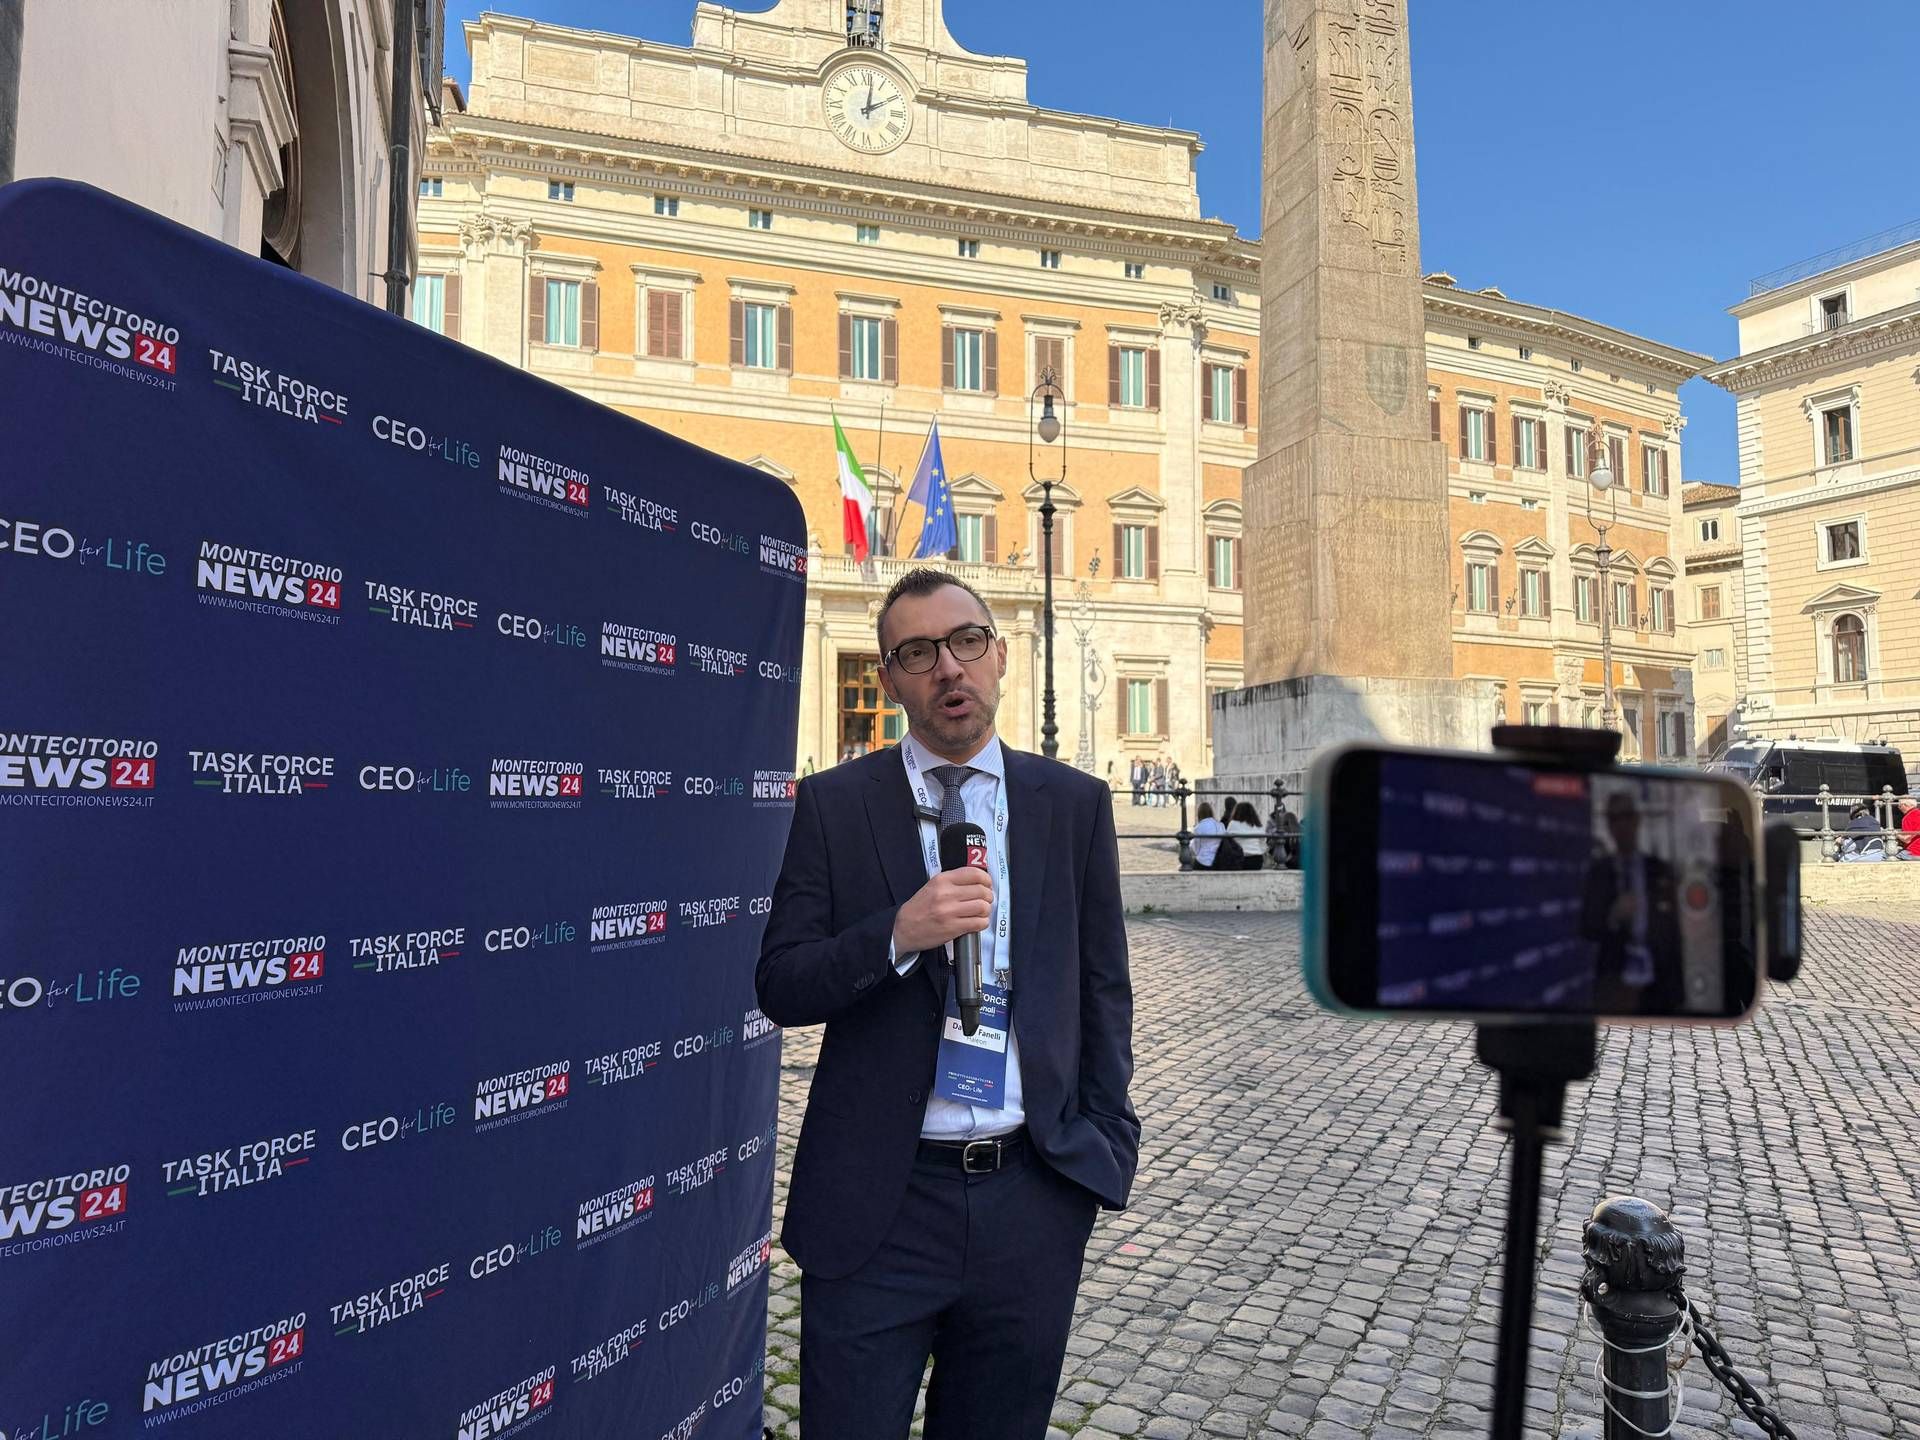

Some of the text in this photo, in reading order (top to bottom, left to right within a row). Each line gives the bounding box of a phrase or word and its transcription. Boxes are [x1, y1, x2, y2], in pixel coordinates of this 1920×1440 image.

[0, 267, 180, 345] MONTECITORIO
[0, 289, 172, 370] NEWS 24
[209, 349, 348, 416] TASK FORCE
[241, 380, 319, 424] ITALIA
[372, 415, 480, 469] CEO for Life
[498, 459, 587, 504] NEWS 24
[499, 444, 589, 486] MONTECITORIO
[603, 485, 678, 524] TASK FORCE
[620, 506, 662, 532] ITALIA
[691, 520, 721, 545] CEO
[728, 533, 750, 555] Life
[78, 537, 103, 566] for
[106, 538, 166, 576] Life
[199, 541, 342, 583] MONTECITORIO
[759, 545, 797, 571] NEWS
[197, 560, 337, 606] NEWS 24
[365, 581, 478, 618] TASK FORCE
[198, 593, 341, 625] WWW.MONTECITORIONEWS24.IT
[391, 605, 453, 631] ITALIA
[497, 613, 587, 648] CEO Life
[602, 621, 676, 646] MONTECITORIO
[601, 636, 674, 663] NEWS 24
[687, 643, 748, 666] TASK FORCE
[701, 659, 735, 676] ITALIA
[759, 660, 781, 680] CEO
[115, 762, 151, 786] 24
[188, 751, 334, 776] TASK FORCE
[359, 765, 415, 791] CEO
[433, 767, 471, 792] Life
[491, 758, 583, 775] MONTECITORIO
[598, 768, 672, 785] TASK FORCE
[222, 773, 302, 795] ITALIA
[489, 774, 580, 797] NEWS 24
[614, 784, 656, 799] ITALIA
[684, 777, 714, 796] CEO
[723, 777, 744, 797] Life
[752, 782, 787, 798] NEWS
[490, 800, 582, 809] WWW.MONTECITORIONEWS24.IT
[592, 900, 667, 920] MONTECITORIO
[679, 896, 740, 916] TASK FORCE
[692, 911, 726, 928] ITALIA
[749, 896, 772, 915] CEO
[349, 928, 465, 957] TASK FORCE
[484, 926, 530, 952] CEO
[544, 921, 576, 945] Life
[590, 914, 664, 942] NEWS 24
[176, 935, 326, 966] MONTECITORIO
[375, 948, 439, 973] ITALIA
[46, 979, 75, 1008] for
[76, 968, 141, 1002] Life
[173, 955, 320, 996] NEWS 24
[173, 984, 323, 1013] WWW.MONTECITORIONEWS24.IT
[981, 993, 1008, 1007] ORCE
[673, 1034, 704, 1060] CEO
[714, 1025, 734, 1048] Life
[978, 1028, 1001, 1041] Fanelli
[585, 1041, 661, 1075] TASK FORCE
[602, 1061, 645, 1085] ITALIA
[476, 1060, 570, 1096] MONTECITORIO
[474, 1076, 567, 1120] NEWS 24
[341, 1116, 399, 1151] CEO
[417, 1103, 456, 1132] Life
[162, 1129, 316, 1183] TASK FORCE
[738, 1135, 760, 1162] CEO
[198, 1158, 283, 1196] ITALIA
[666, 1147, 729, 1186] TASK FORCE
[680, 1168, 714, 1195] ITALIA
[85, 1188, 121, 1218] 24
[578, 1174, 655, 1216] MONTECITORIO
[576, 1191, 652, 1240] NEWS 24
[469, 1244, 515, 1279] CEO
[530, 1226, 562, 1256] Life
[727, 1252, 761, 1291] NEWS
[330, 1263, 450, 1325] TASK FORCE
[357, 1291, 424, 1333] ITALIA
[659, 1299, 689, 1331] CEO
[147, 1312, 306, 1381] MONTECITORIO
[571, 1319, 647, 1375] TASK FORCE
[588, 1345, 629, 1380] ITALIA
[143, 1334, 300, 1412] NEWS 24
[144, 1361, 304, 1429] WWW.MONTECITORIONEWS24.IT
[459, 1364, 556, 1428] MONTECITORIO
[713, 1377, 742, 1409] CEO
[42, 1399, 109, 1440] Life
[458, 1394, 530, 1440] NEWS
[532, 1382, 551, 1406] 24
[677, 1401, 707, 1437] FORCE
